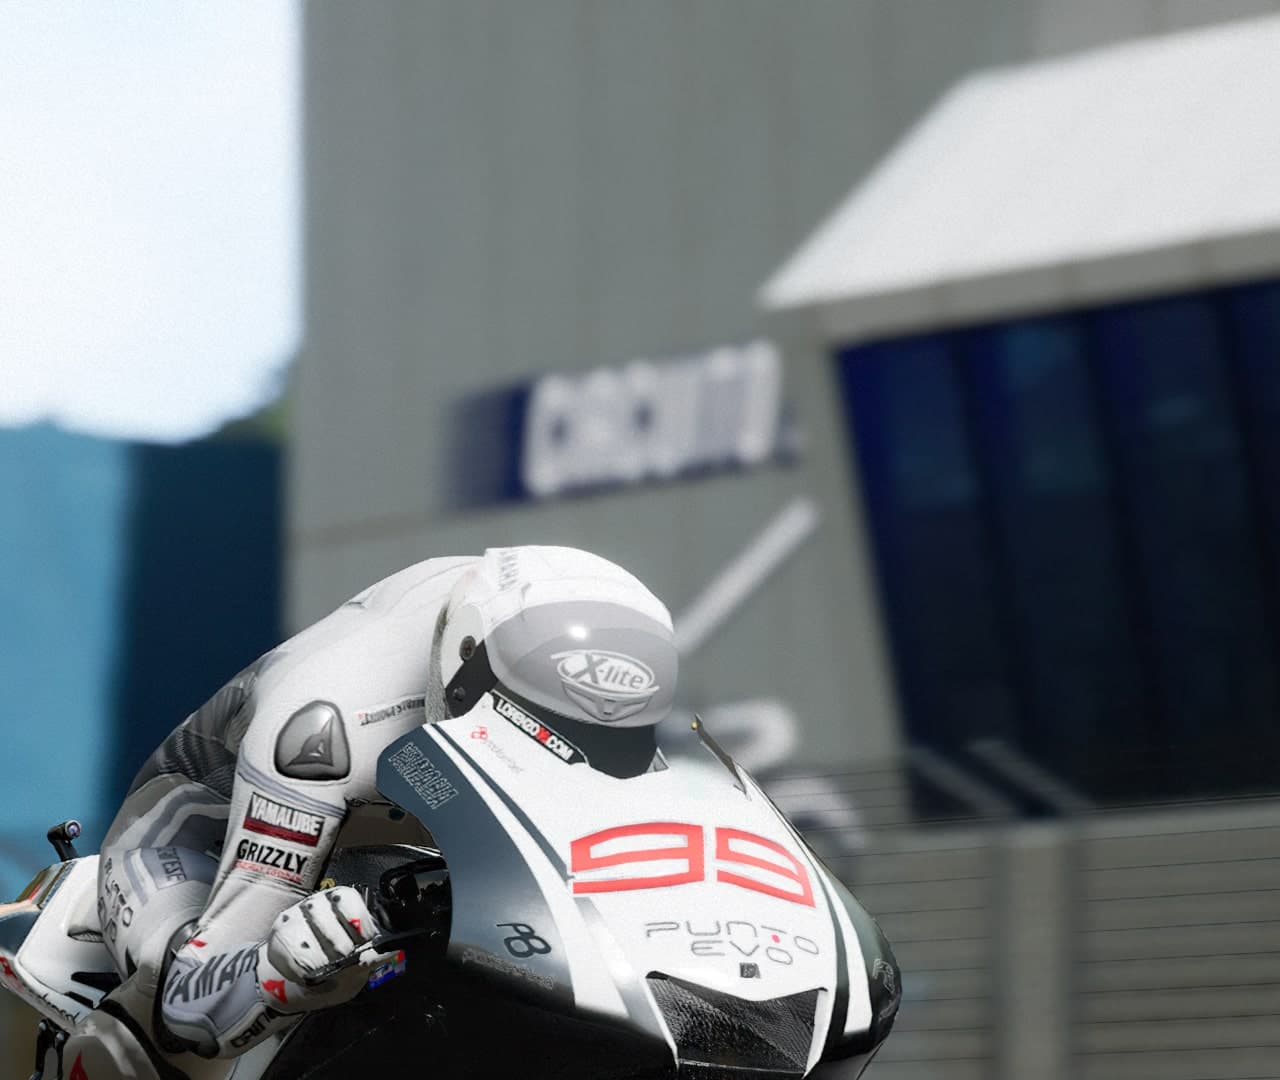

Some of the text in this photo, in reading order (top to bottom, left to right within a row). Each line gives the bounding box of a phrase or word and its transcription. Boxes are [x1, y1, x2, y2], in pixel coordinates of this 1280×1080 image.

[250, 795, 322, 836] YAMALUBE
[237, 838, 308, 875] GRIZZLY
[570, 822, 816, 909] 99
[644, 919, 819, 955] PUNTO
[692, 939, 793, 966] EVO
